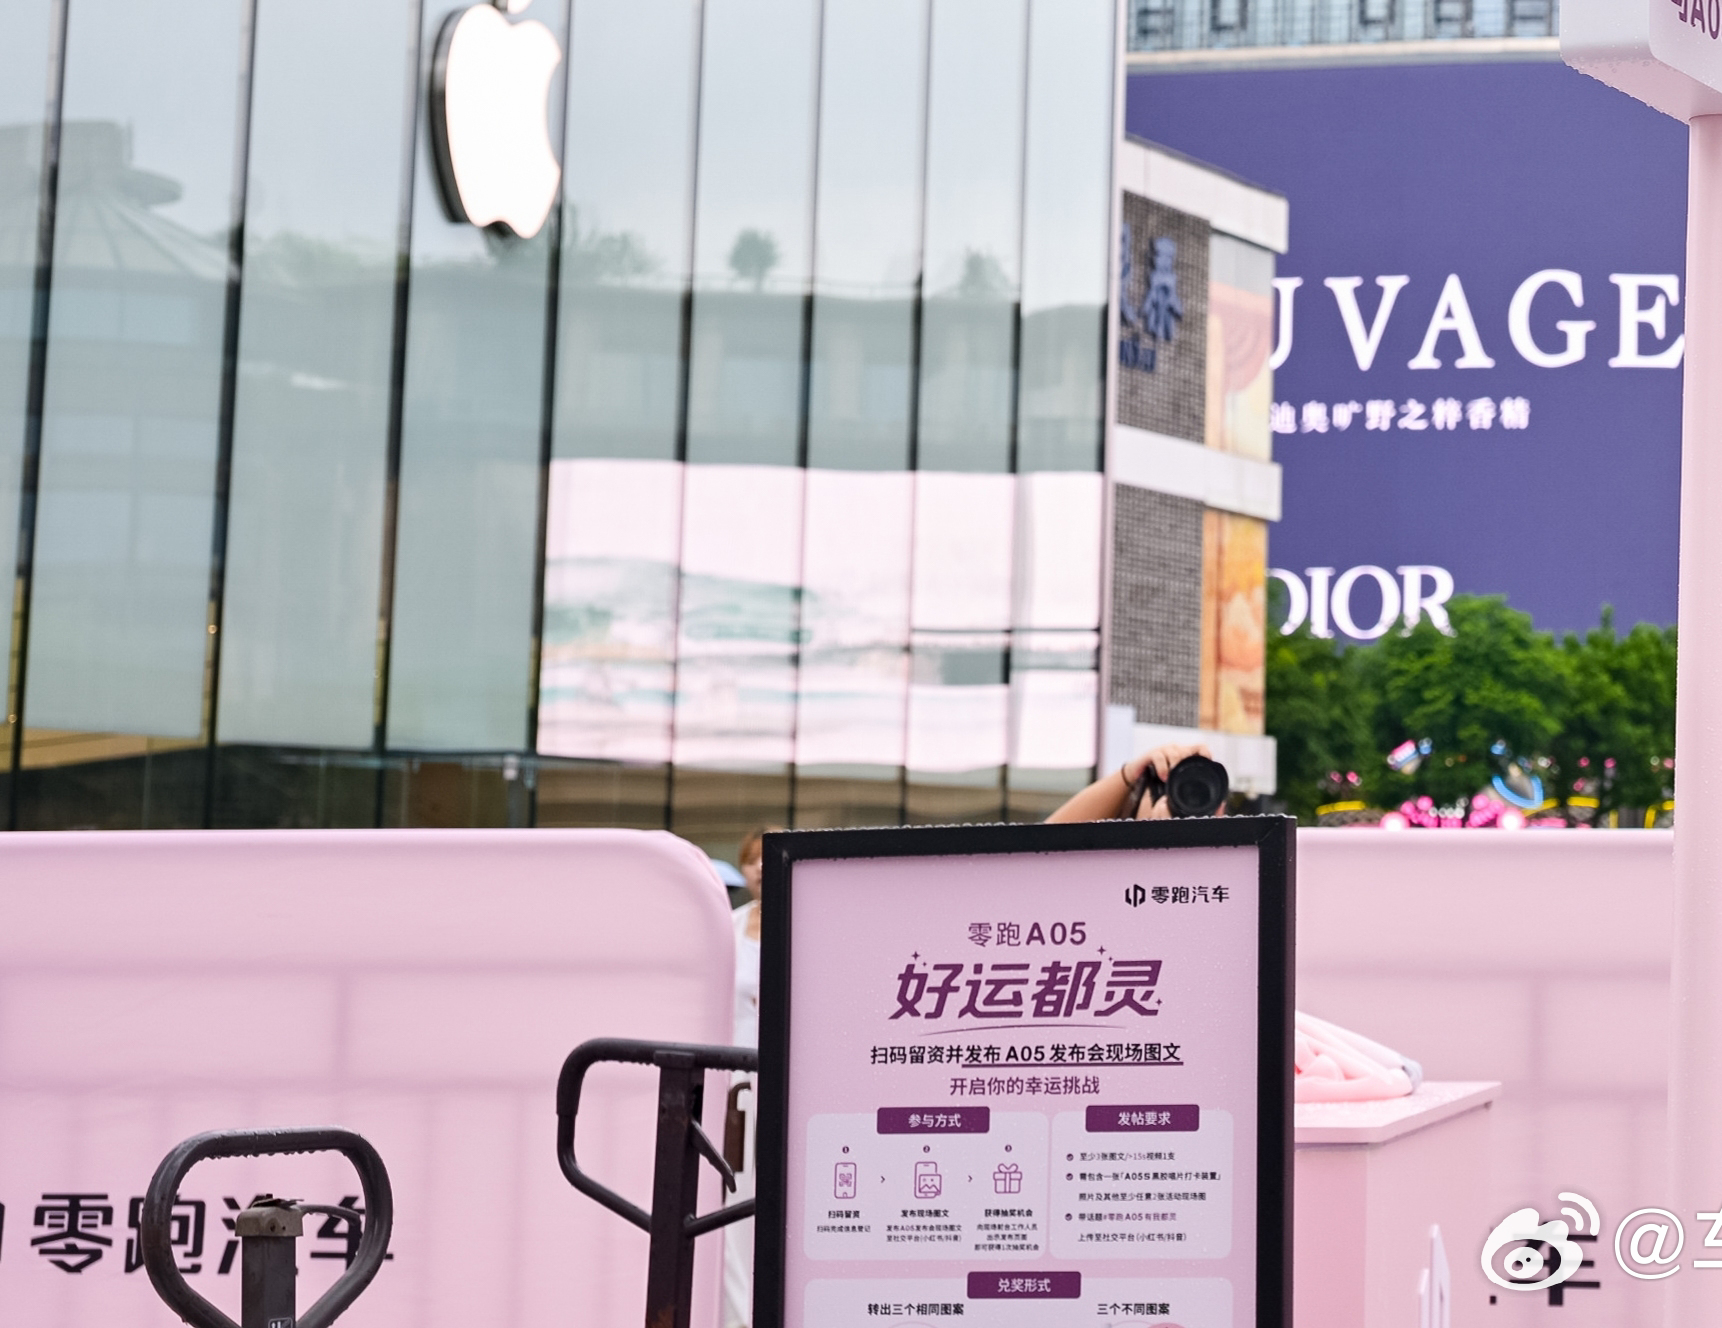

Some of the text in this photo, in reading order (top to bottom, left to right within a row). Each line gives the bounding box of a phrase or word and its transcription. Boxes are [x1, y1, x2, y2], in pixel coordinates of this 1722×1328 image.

[1151, 885, 1230, 904] 零跑汽车
[888, 960, 1163, 1020] 好运都灵
[950, 1076, 1100, 1096] 开启你的幸运挑战
[908, 1114, 962, 1128] 参与方式
[1117, 1111, 1171, 1126] 发帖要求
[828, 1210, 860, 1219] 扫码留资
[901, 1209, 949, 1218] 发布现场图文
[984, 1208, 1033, 1218] 获得抽奖机会
[997, 1278, 1051, 1293] 兑奖形式
[867, 1302, 964, 1317] 转出三个相同图案
[1097, 1302, 1170, 1316] 三个不同图案
